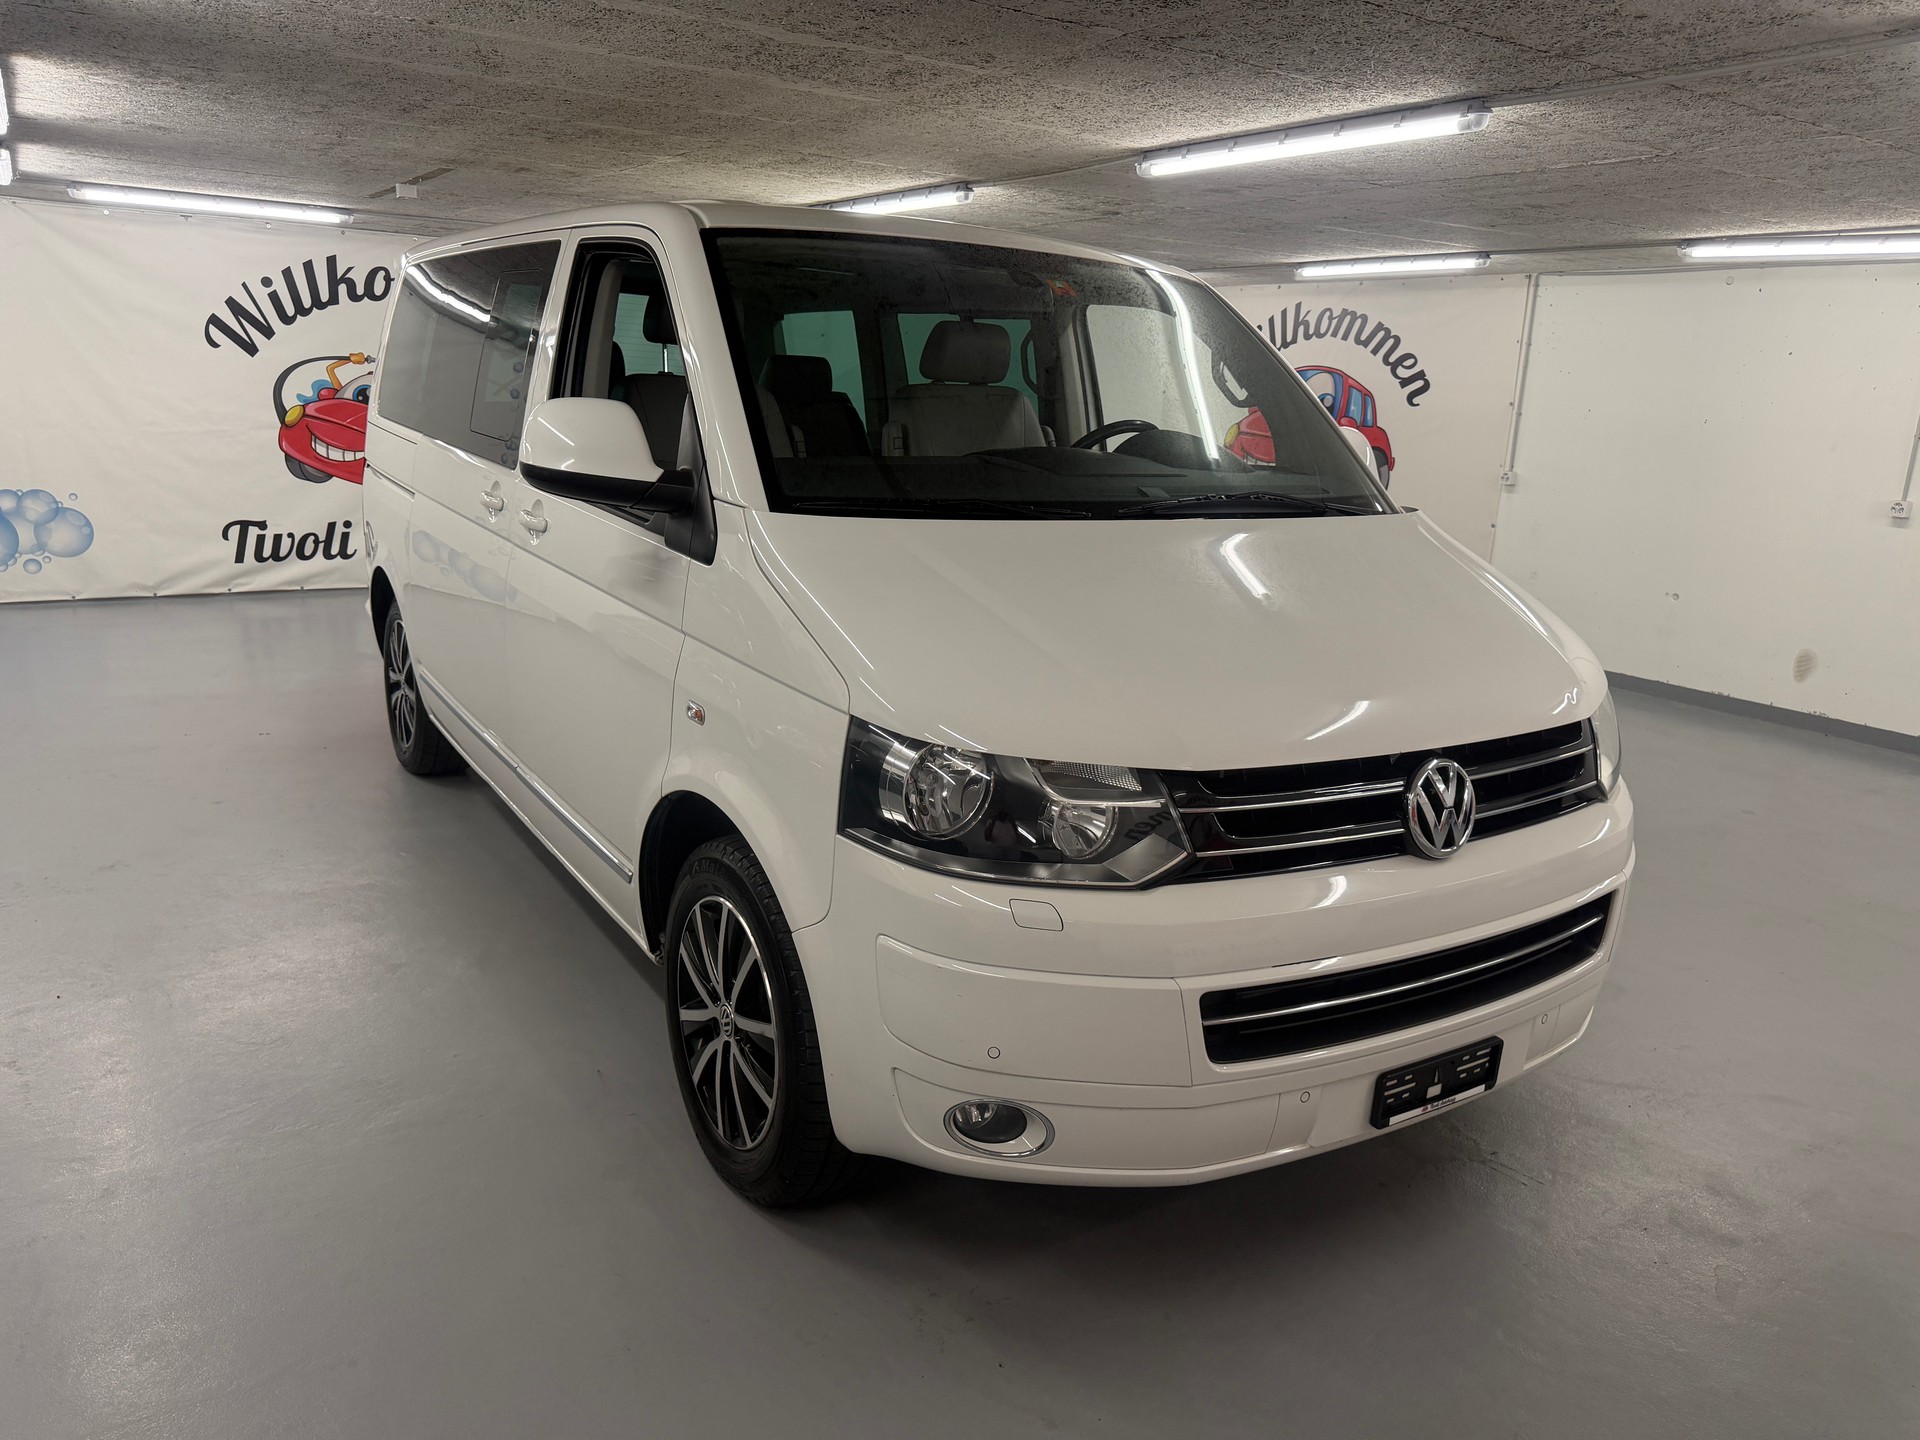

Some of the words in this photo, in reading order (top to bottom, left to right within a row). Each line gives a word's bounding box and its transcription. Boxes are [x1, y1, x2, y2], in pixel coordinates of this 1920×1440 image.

[204, 254, 395, 358] Willko
[1257, 301, 1431, 407] llkommen
[221, 519, 357, 564] Tivoli
[1413, 762, 1473, 853] VW
